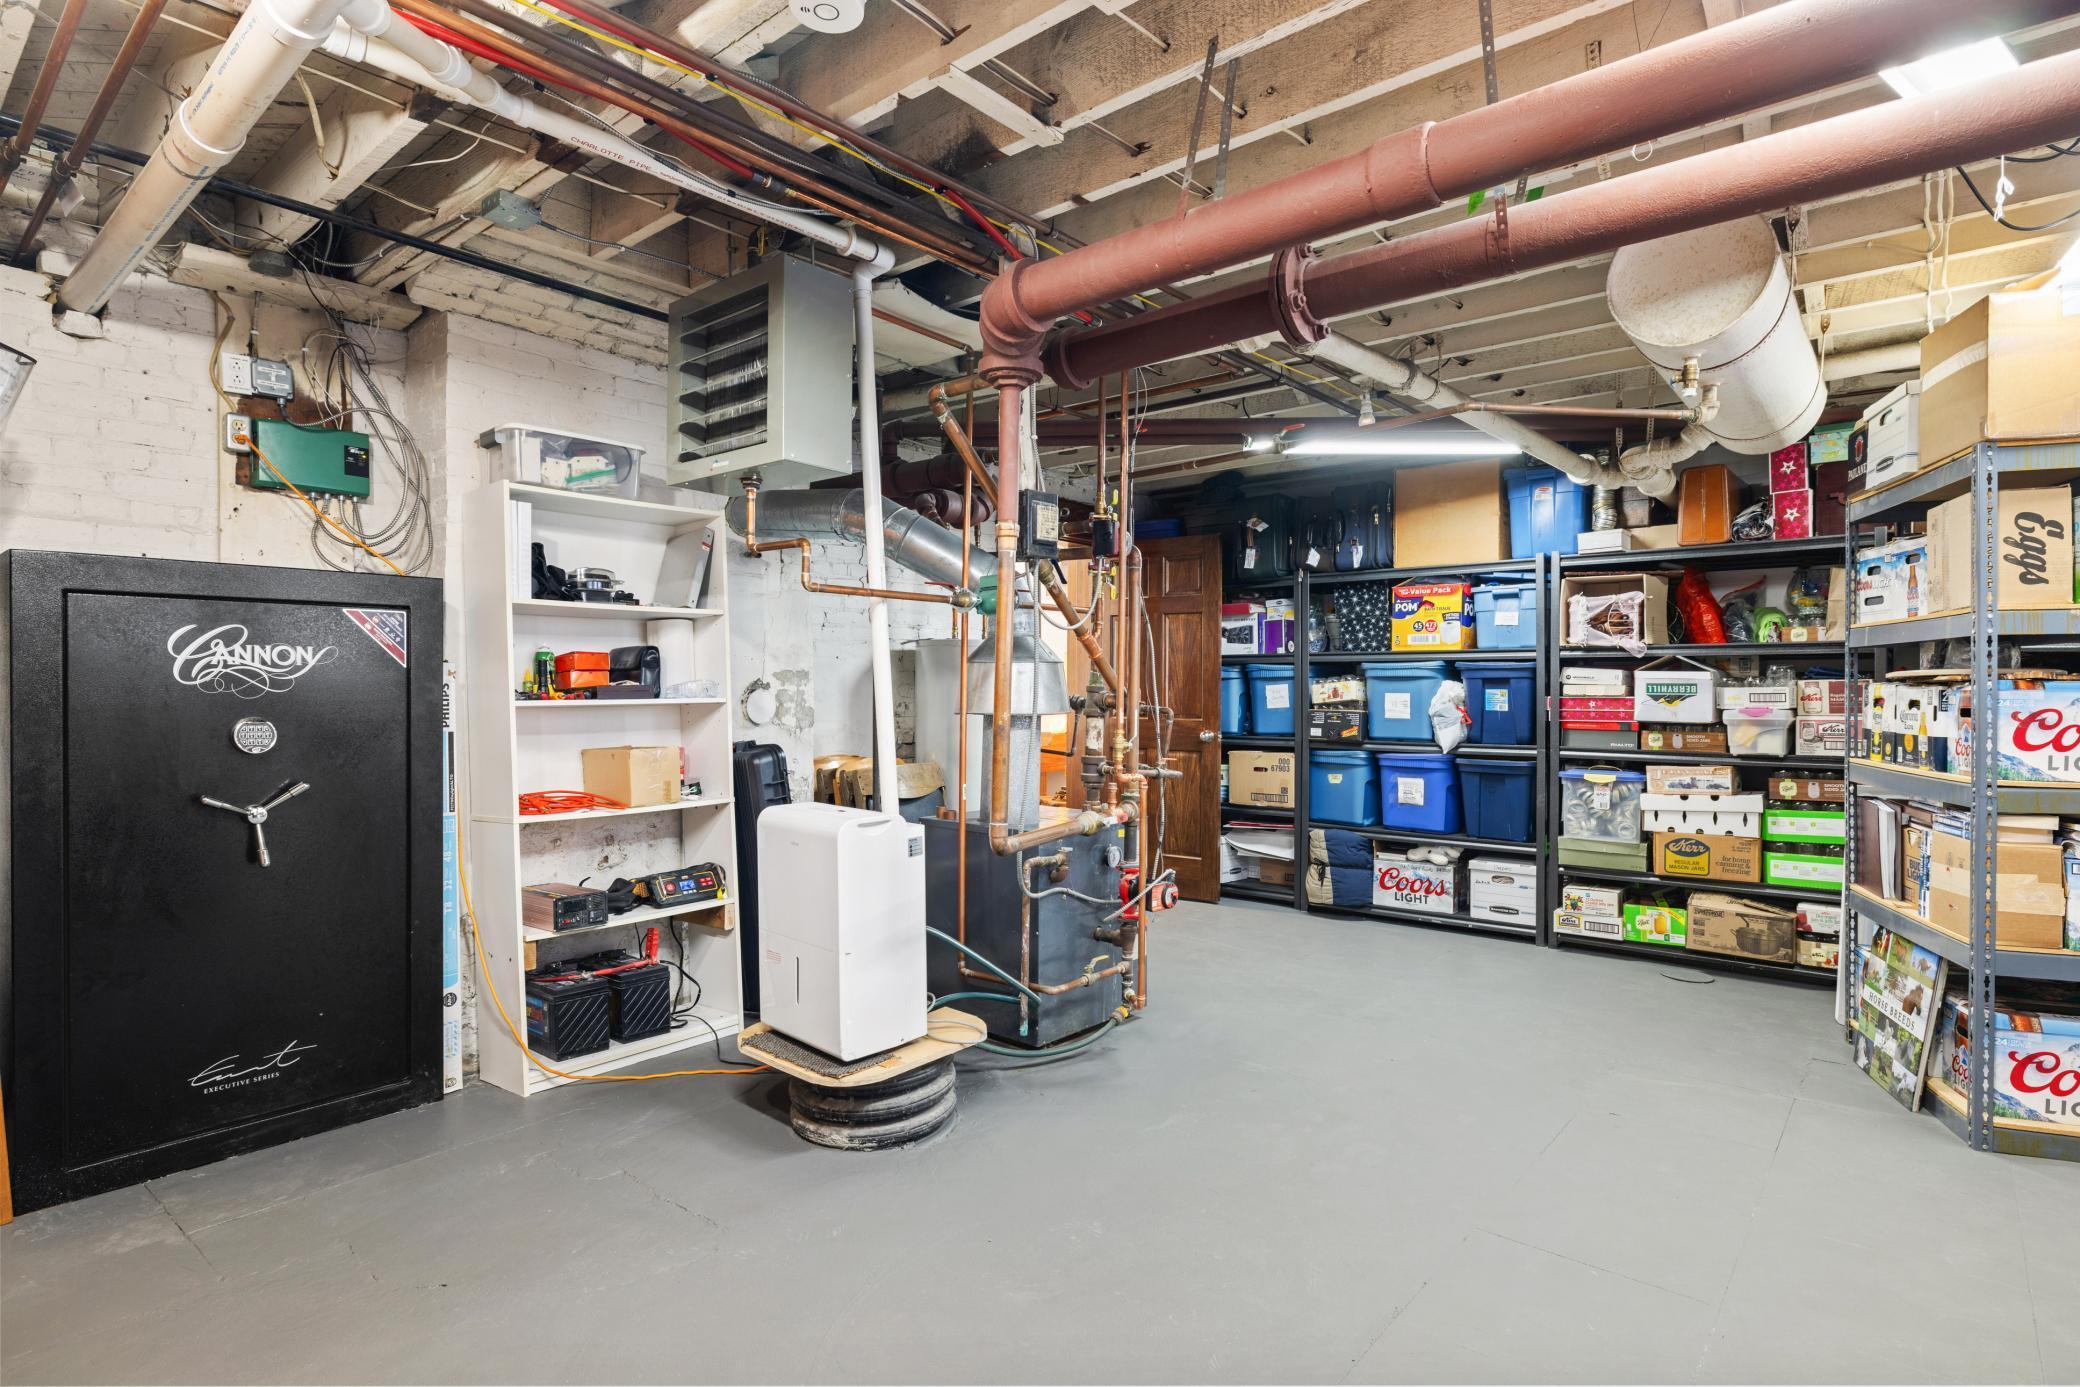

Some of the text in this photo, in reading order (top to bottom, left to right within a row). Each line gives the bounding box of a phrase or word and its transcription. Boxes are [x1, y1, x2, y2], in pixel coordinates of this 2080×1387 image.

[569, 136, 651, 173] CHARLOTTE PIPE
[2003, 511, 2065, 585] Eggs
[1410, 587, 1431, 595] Value
[1432, 586, 1452, 594] Pack
[1394, 602, 1418, 612] POM
[167, 623, 339, 699] CANNON
[1647, 685, 1697, 693] BERRYHILL
[1668, 838, 1707, 853] Kerr
[1378, 867, 1446, 897] Coors
[1394, 891, 1430, 904] LIGHT
[1868, 992, 1915, 1031] HORSE BREEDS
[1994, 1037, 2008, 1045] 24
[203, 1071, 281, 1095] EXECUTIVE SERIES
